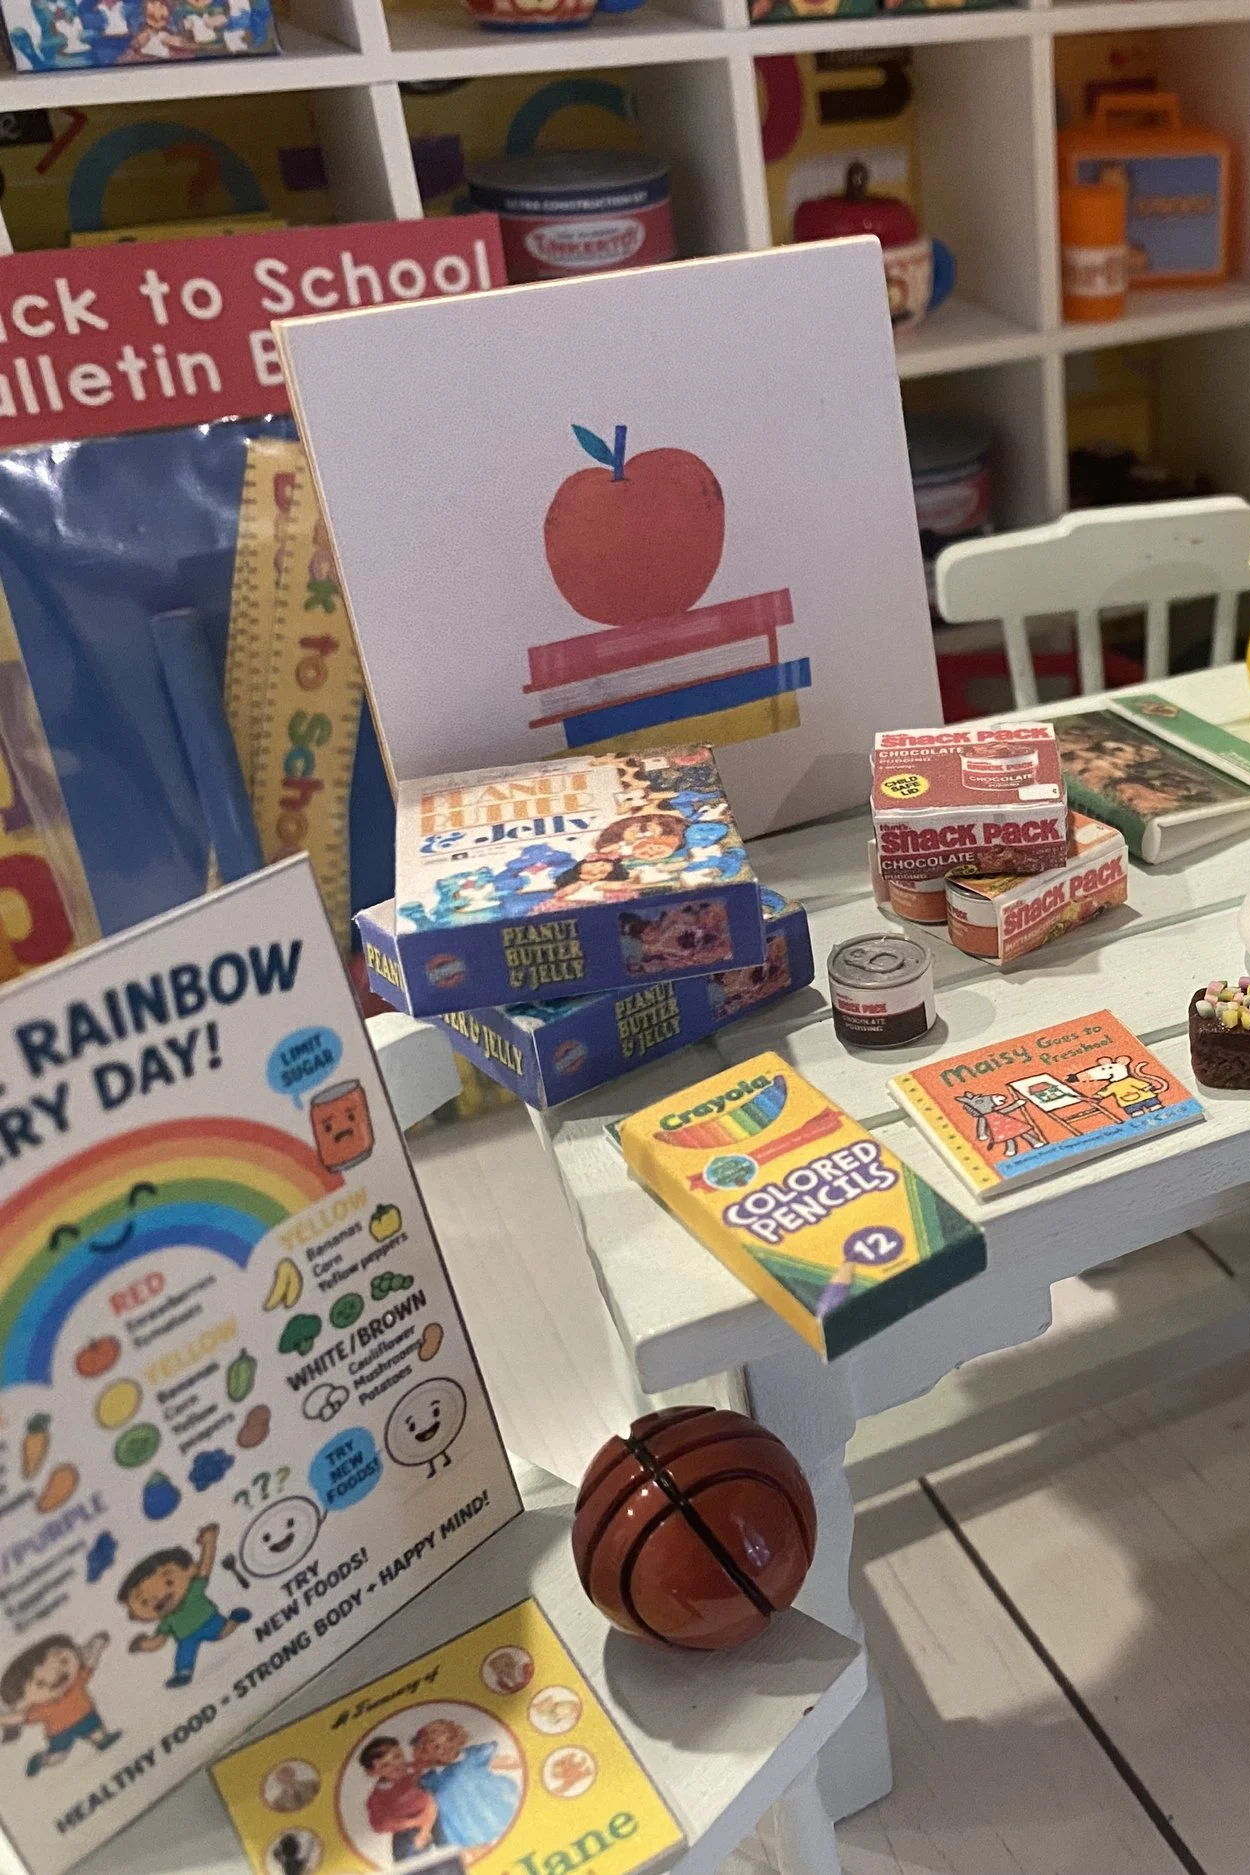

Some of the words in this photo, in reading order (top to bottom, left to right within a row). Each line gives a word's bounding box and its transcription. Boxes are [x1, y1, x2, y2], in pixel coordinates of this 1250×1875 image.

[0, 277, 108, 342] ck
[140, 267, 223, 325] to
[254, 239, 492, 313] School
[879, 747, 964, 758] CHOCOLATE
[884, 775, 918, 787] CHILD
[891, 781, 921, 793] SAFE
[901, 788, 919, 797] LID
[882, 853, 975, 871] CHOCOLATE
[502, 919, 580, 947] PEANUT
[503, 940, 584, 968] BUTTER
[532, 958, 586, 991] JELLY
[16, 939, 303, 1078] RAINBOW
[615, 980, 676, 1020] PEANUT
[617, 998, 681, 1039] BUTTER
[280, 1034, 323, 1067] LIMIT
[483, 1025, 524, 1077] JELLY
[636, 1018, 682, 1058] JELLY
[939, 1046, 1033, 1088] Maisy
[1036, 1030, 1080, 1050] Goes
[1084, 1025, 1102, 1036] to
[1039, 1034, 1114, 1066] Preschool
[93, 1021, 222, 1111] DAY!
[280, 1049, 336, 1088] SUGAR
[659, 1072, 774, 1132] Crayola
[725, 1141, 880, 1226] COLORED
[752, 1162, 897, 1243] PENCILS
[305, 1222, 363, 1263] Bananas
[317, 1263, 359, 1292] Yellow
[361, 1232, 409, 1270] peppers
[854, 1232, 898, 1261] 12
[312, 1254, 343, 1278] Corn
[109, 1271, 167, 1317] RED
[348, 1325, 416, 1376] Cauliflower
[353, 1338, 423, 1390] Mushrooms
[358, 1364, 412, 1406] Potatoes
[324, 1440, 355, 1466] TRY
[330, 1454, 364, 1484] NEW
[326, 1455, 381, 1504] FOODS!
[254, 1601, 301, 1643] NEW
[304, 1546, 370, 1606] FOODS!
[281, 1560, 320, 1598] TRY
[55, 1747, 157, 1836] HEALTHY
[161, 1704, 218, 1756] FOOD
[233, 1633, 313, 1699] STRONG
[316, 1590, 363, 1638] BODY
[379, 1531, 436, 1588] HAPPY
[440, 1489, 491, 1538] MIND!
[517, 1811, 639, 1875] Jane
